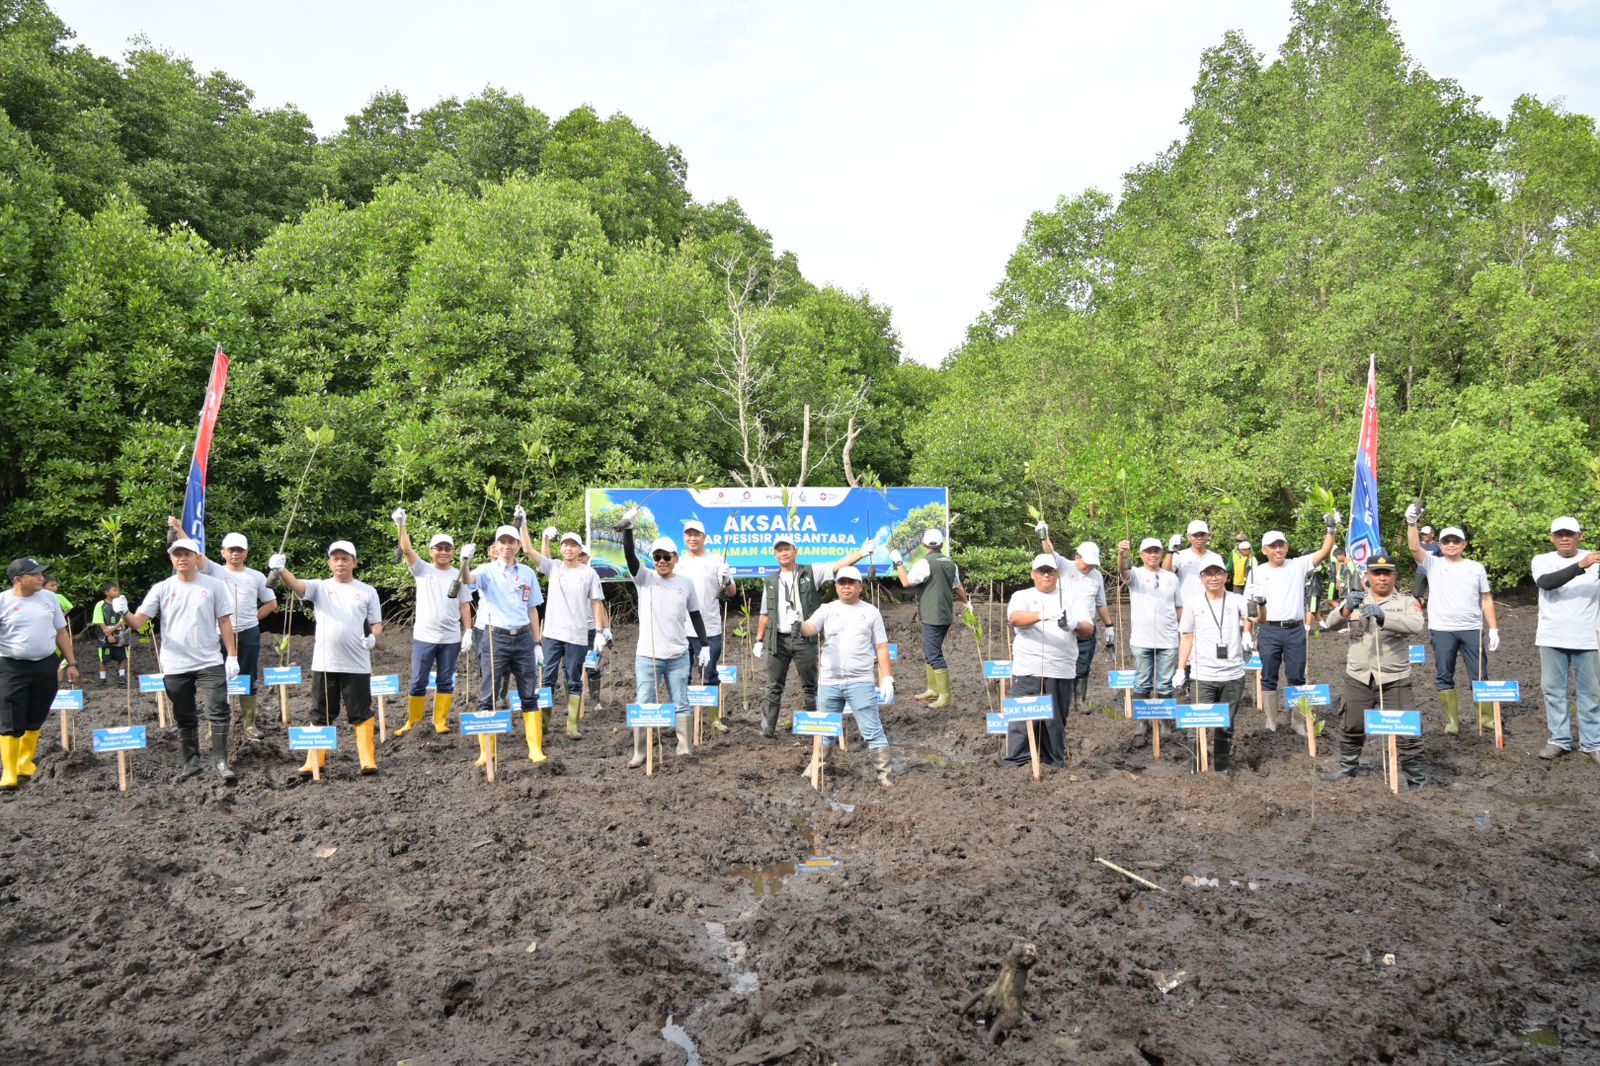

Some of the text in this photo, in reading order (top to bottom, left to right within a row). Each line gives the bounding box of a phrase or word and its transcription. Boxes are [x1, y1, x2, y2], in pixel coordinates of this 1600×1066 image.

[724, 514, 818, 532] AKSARA
[725, 533, 773, 544] PESISIR
[775, 533, 856, 545] NUSANTARA
[1003, 704, 1052, 715] SKK MIGAS
